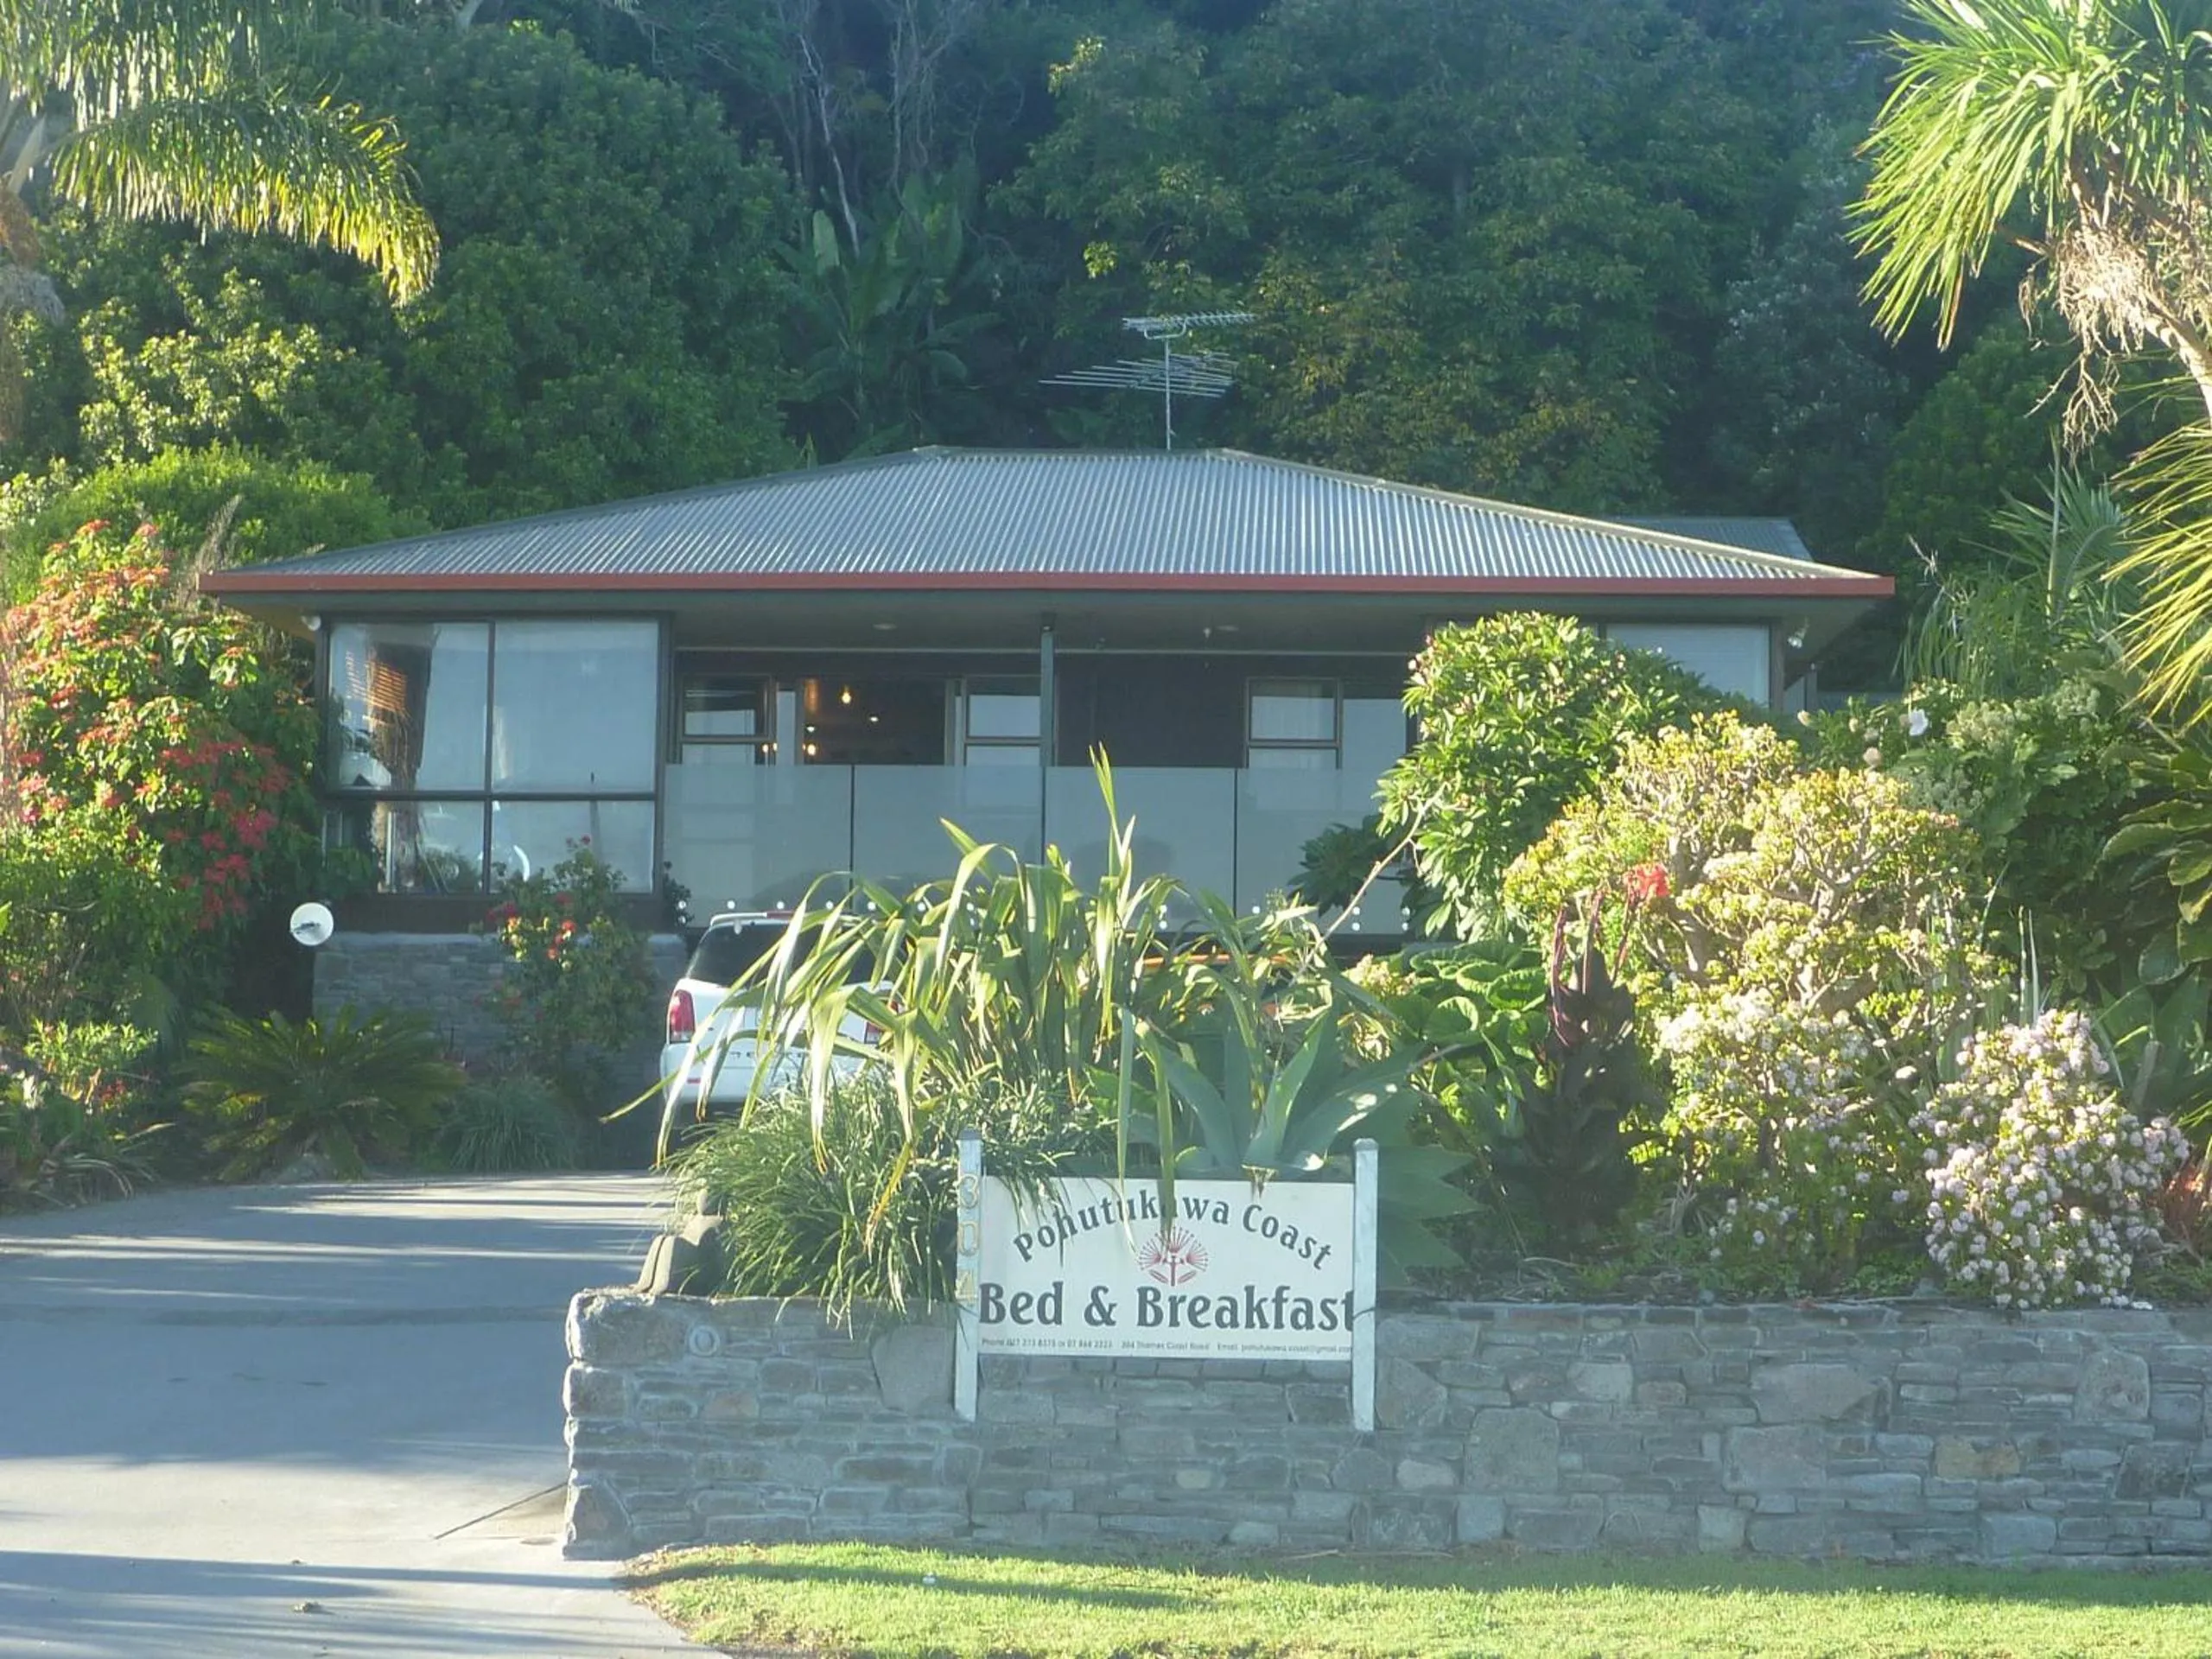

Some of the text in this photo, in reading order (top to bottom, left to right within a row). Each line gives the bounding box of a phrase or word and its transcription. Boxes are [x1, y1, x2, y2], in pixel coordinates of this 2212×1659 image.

[1242, 1204, 1332, 1270] Coast
[978, 1281, 1354, 1333] Bed & Breakfast
